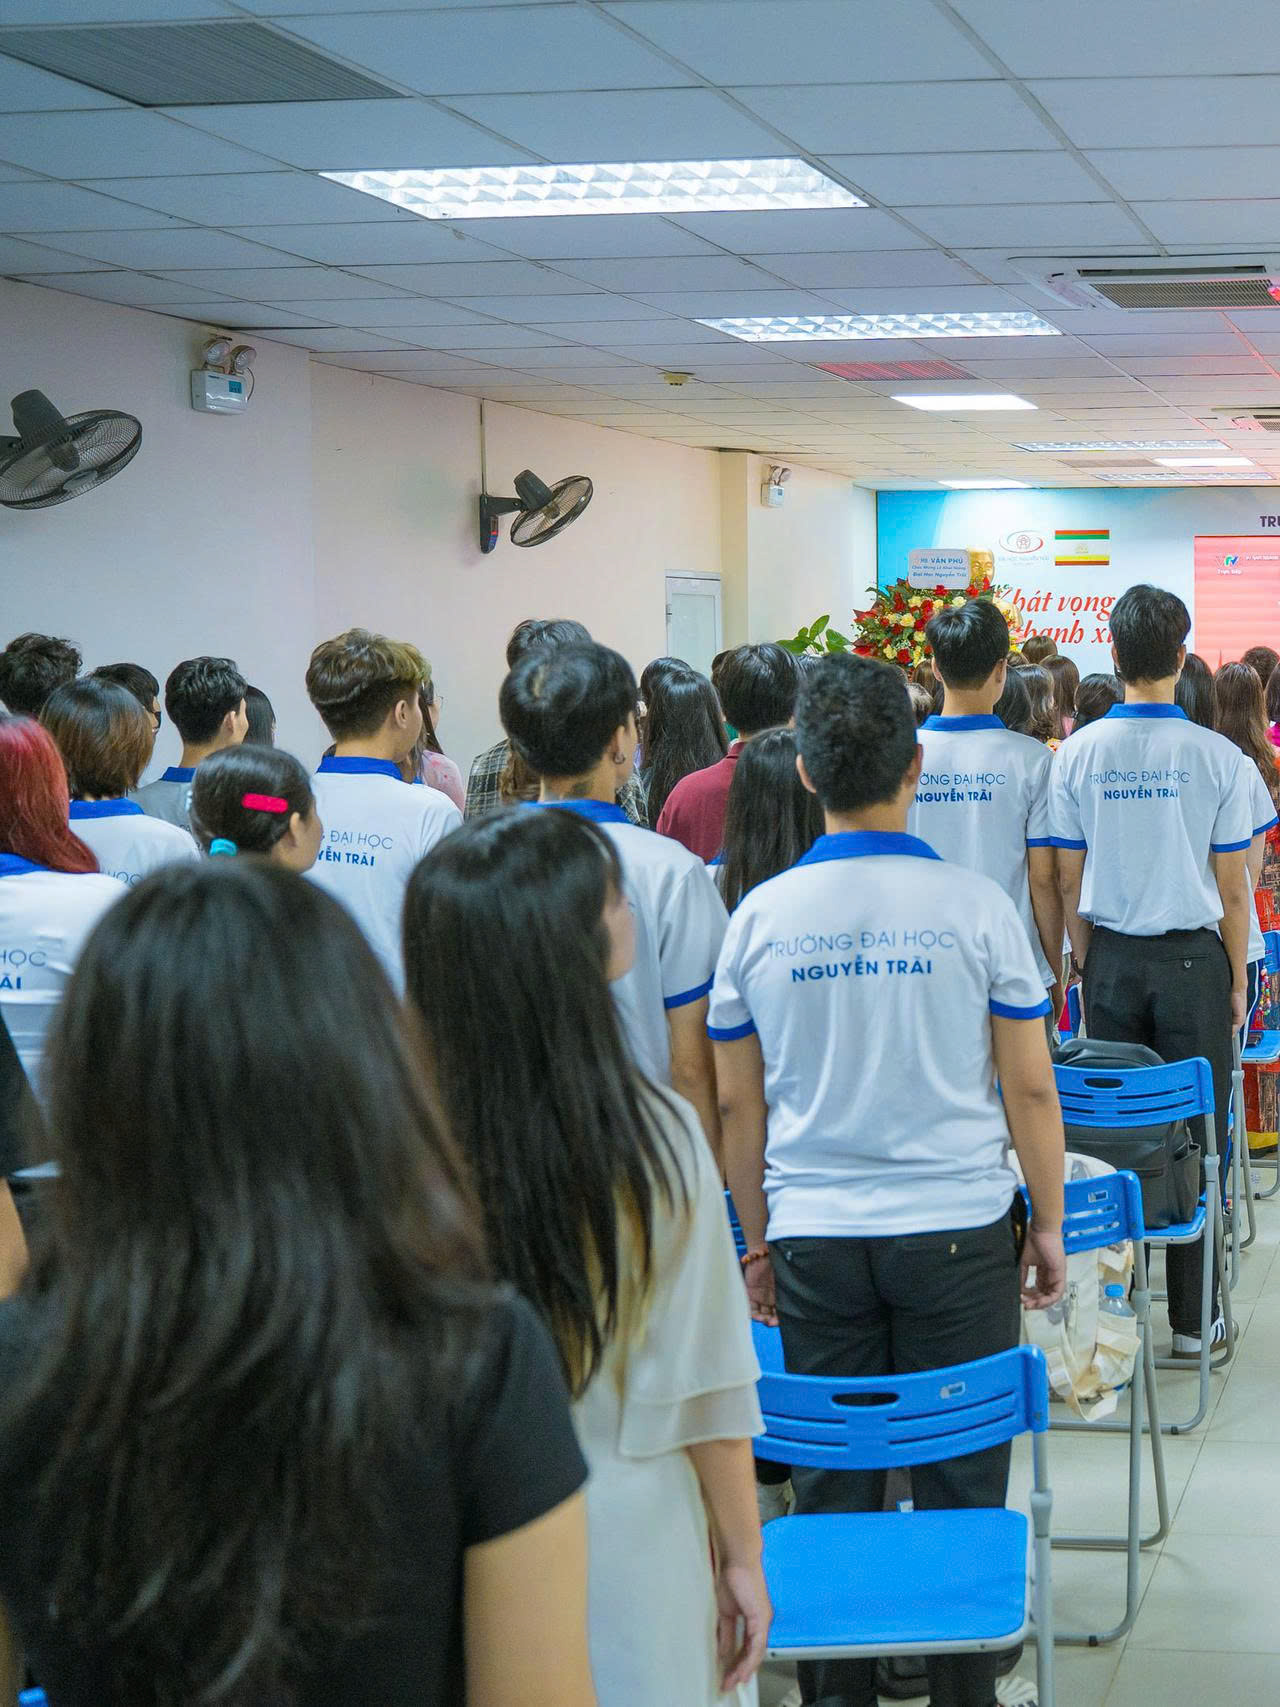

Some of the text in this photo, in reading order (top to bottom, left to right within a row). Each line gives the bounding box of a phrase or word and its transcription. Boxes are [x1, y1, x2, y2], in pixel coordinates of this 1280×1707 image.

[995, 587, 1116, 621] hát vọng
[1014, 619, 1085, 644] hanh
[919, 773, 1006, 788] ỜNG ĐẠI HỌC
[1089, 769, 1138, 785] TRƯỜNG
[1141, 770, 1162, 784] ĐẠI
[915, 788, 992, 802] NGUYỄN TRÃI
[1104, 785, 1153, 800] NGUYỄN
[330, 830, 394, 850] ĐẠI HỌC
[345, 851, 375, 867] TRÃI
[767, 929, 955, 959] TRƯỜNG ĐẠI HỌC
[791, 952, 932, 982] NGUYỄN TRÃI
